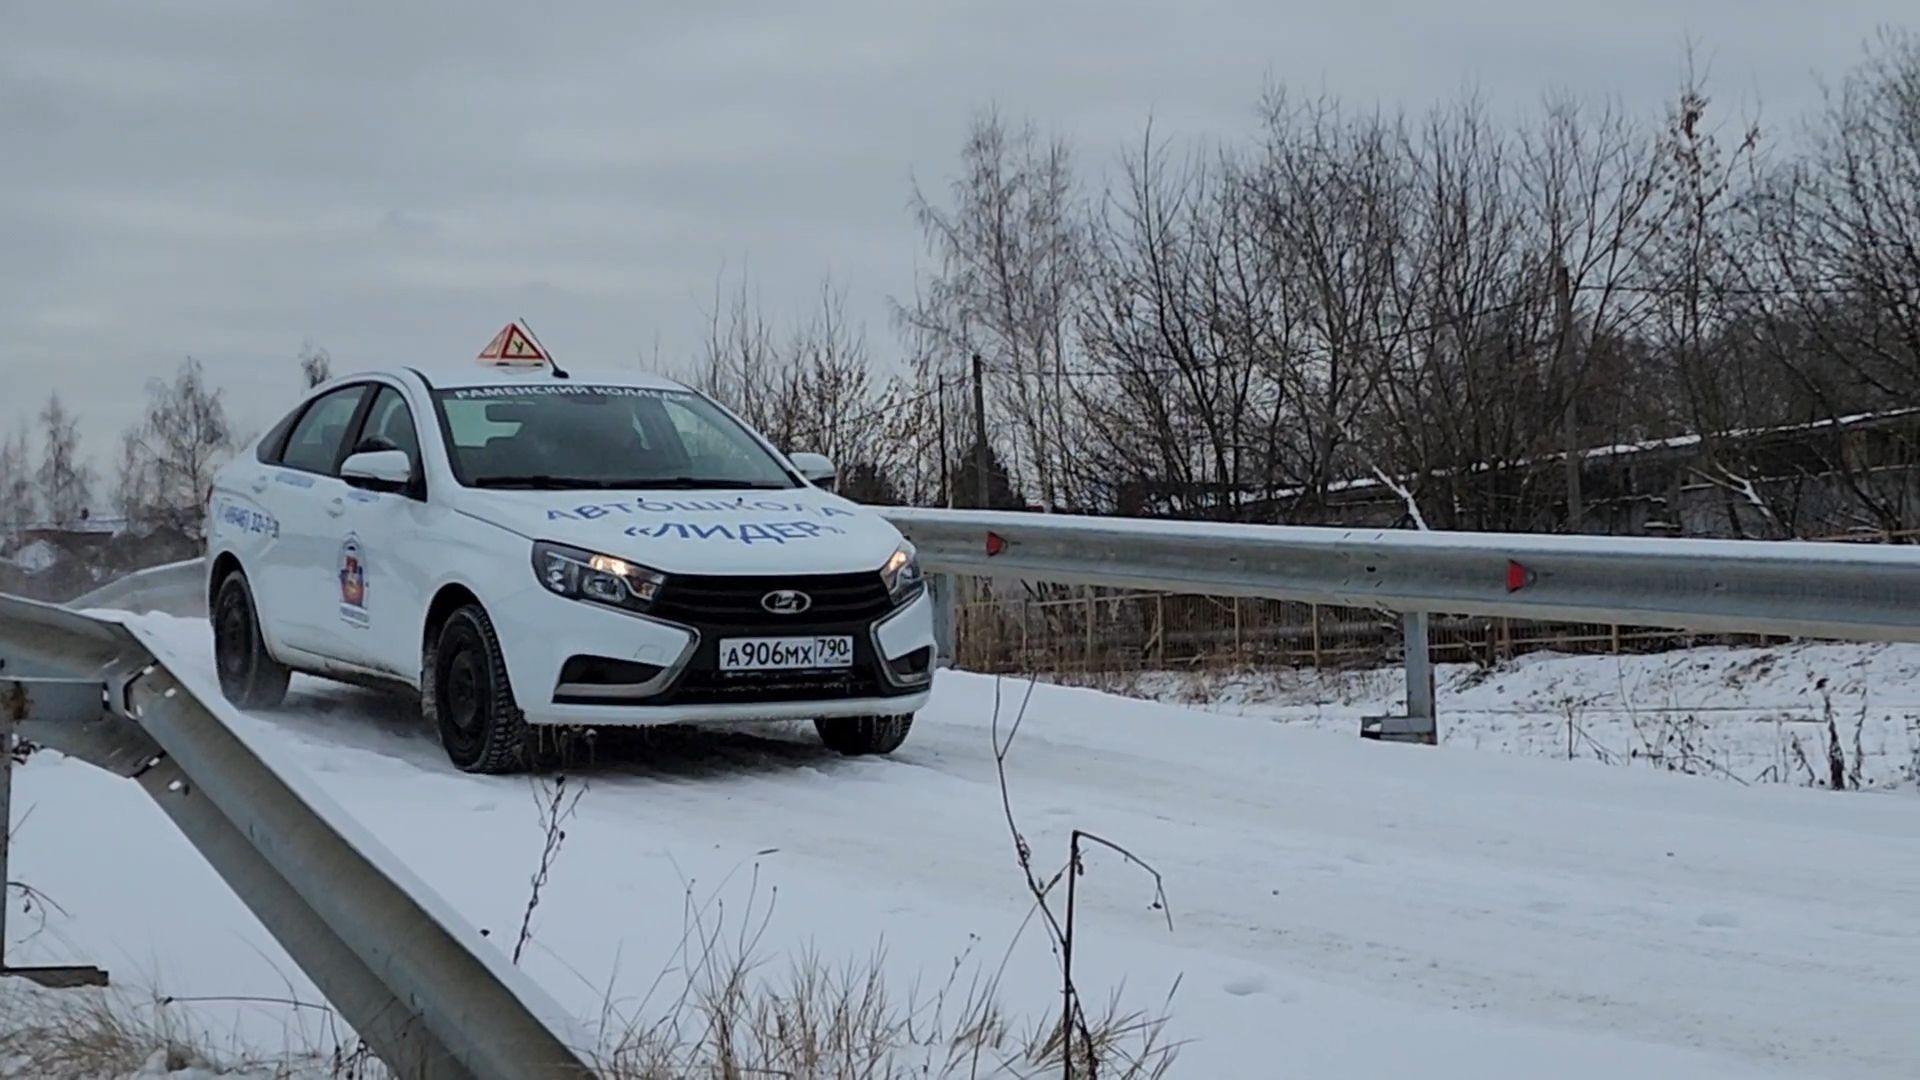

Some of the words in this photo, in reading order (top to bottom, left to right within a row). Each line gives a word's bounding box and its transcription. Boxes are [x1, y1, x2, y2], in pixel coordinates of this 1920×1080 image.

[547, 500, 854, 520] АВТОШКОЛА
[726, 641, 812, 666] А906МХ
[817, 638, 847, 657] 790
